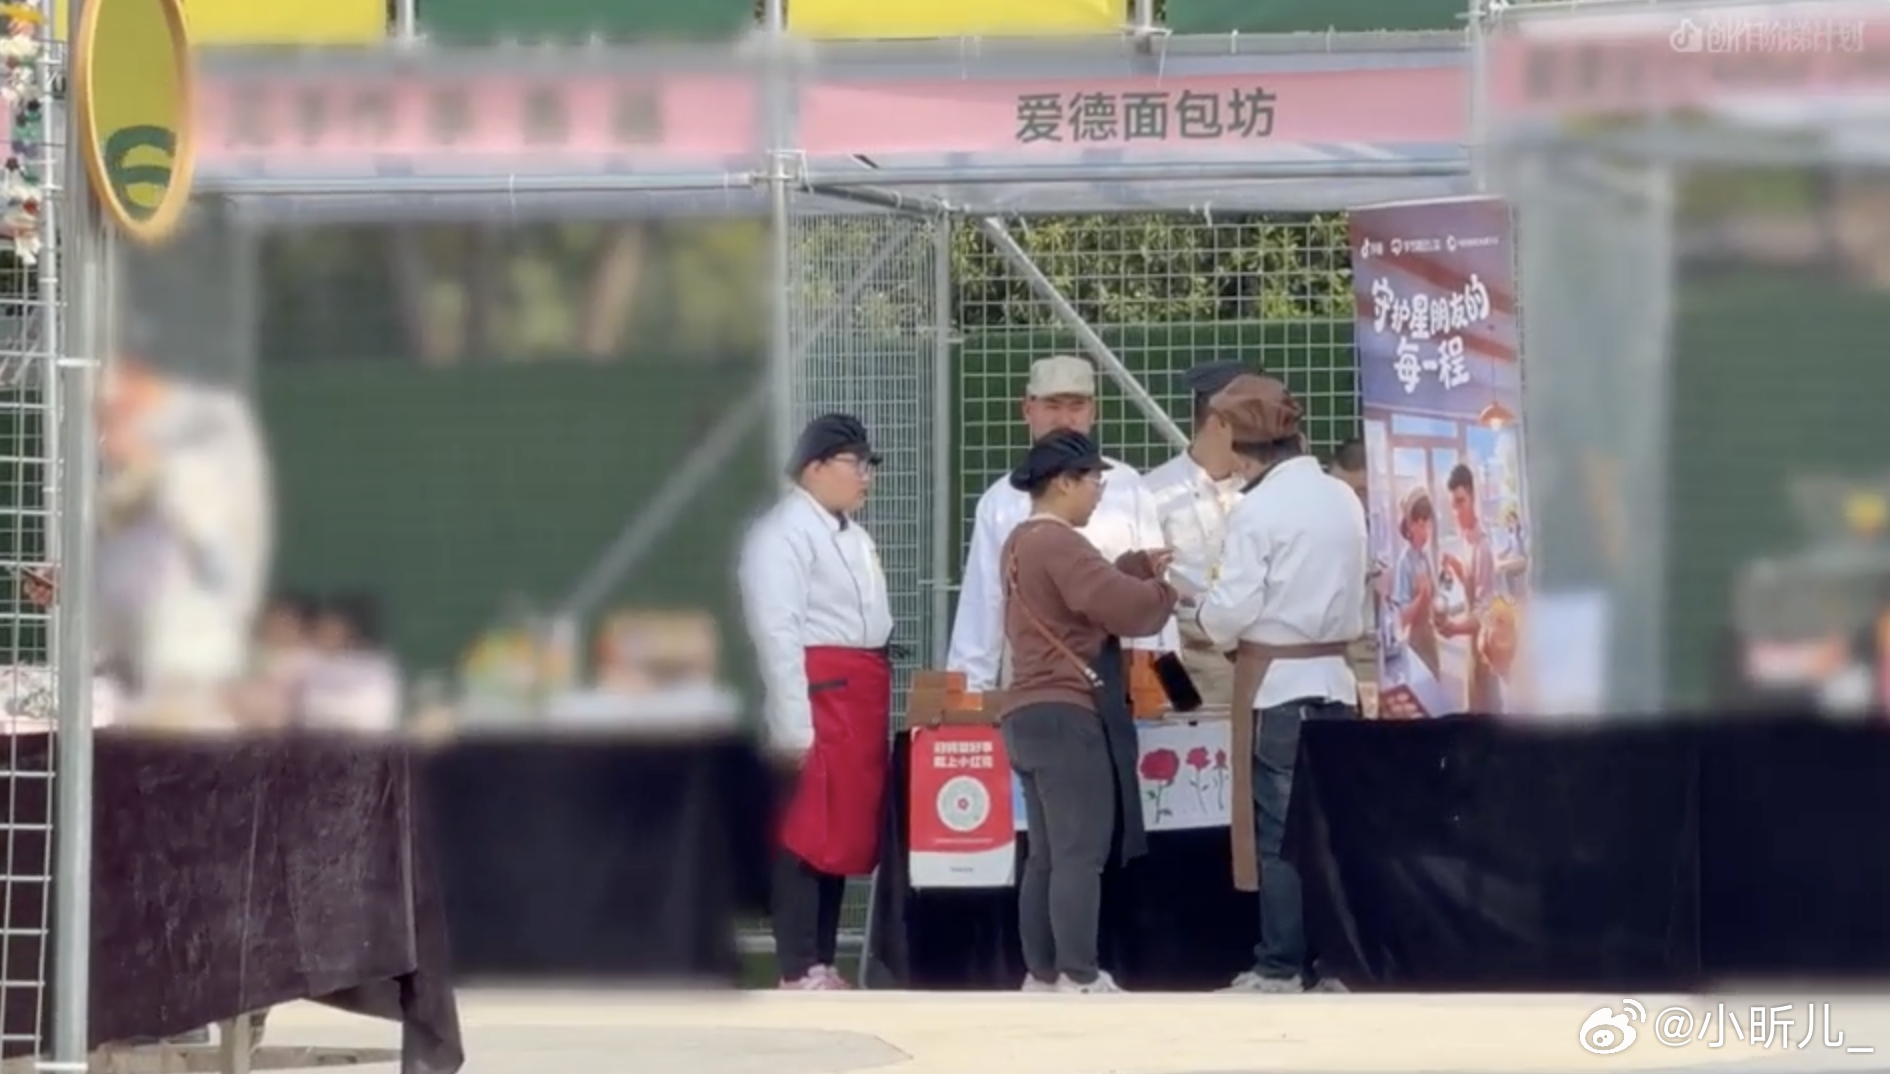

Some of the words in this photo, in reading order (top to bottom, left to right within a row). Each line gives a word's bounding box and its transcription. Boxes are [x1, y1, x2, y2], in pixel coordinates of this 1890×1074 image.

[1016, 87, 1277, 143] 爱德面包坊
[1371, 273, 1490, 339] 守护星朋友的
[1394, 336, 1470, 394] 每一程
